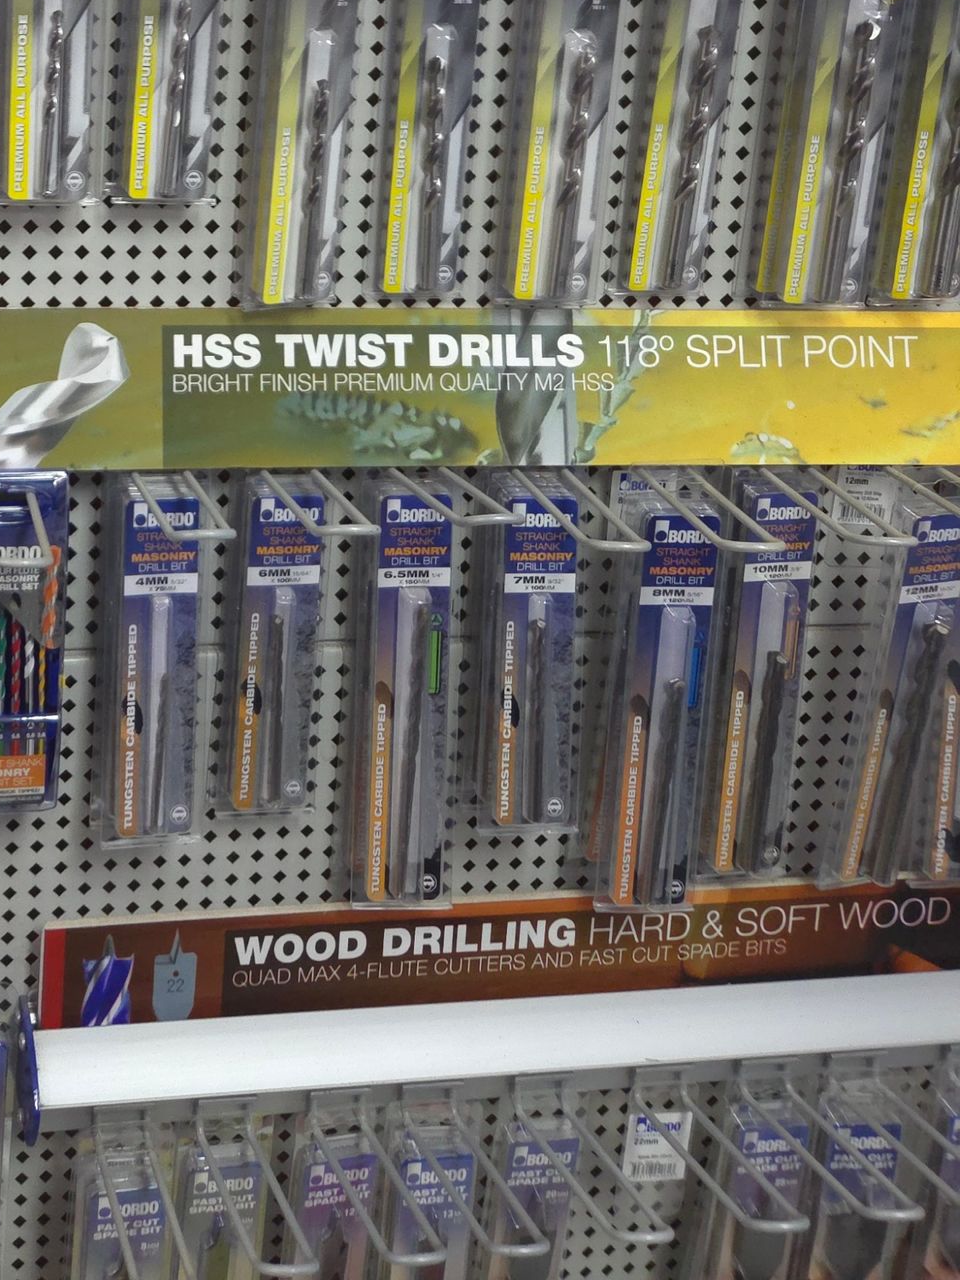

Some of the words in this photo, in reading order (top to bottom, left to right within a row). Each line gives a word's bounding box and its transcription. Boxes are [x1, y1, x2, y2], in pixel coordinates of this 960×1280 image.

[173, 333, 261, 368] HSS
[275, 333, 414, 368] TWIST
[428, 333, 585, 368] DRILLS
[687, 335, 790, 368] SPLIT
[804, 335, 918, 368] POINT
[172, 373, 253, 393] BRIGHT
[260, 373, 327, 392] FINISH
[334, 373, 433, 392] PREMIUM
[440, 373, 527, 392] QUALITY
[535, 373, 564, 391] M2
[572, 373, 614, 391] HSS
[256, 545, 320, 555] MASONRY
[131, 552, 197, 562] MASONRY
[138, 563, 168, 572] DRILL
[171, 561, 188, 571] BIT
[752, 564, 789, 574] 10MM
[258, 569, 290, 577] 6MM
[383, 570, 430, 579] 6.5MM
[135, 577, 169, 586] 4MM
[513, 576, 545, 584] 7MM
[22, 582, 39, 591] SET
[652, 588, 685, 598] 8MM
[127, 624, 137, 680] TIPPED
[125, 685, 136, 746] CARBIDE
[123, 751, 134, 829] TUNGSTEN
[234, 930, 367, 965] WOOD
[382, 917, 576, 958] DRILLING
[589, 912, 691, 945] HARD
[702, 910, 724, 939] &
[736, 903, 830, 938] SOFT
[839, 897, 951, 930] WOOD
[232, 967, 291, 988] QUAD
[297, 964, 341, 983] MAX
[347, 960, 428, 980] 4-FLUTE
[434, 951, 526, 975] CUTTERS
[531, 950, 574, 970] AND
[579, 947, 625, 966] FAST
[632, 944, 671, 963] CUT
[677, 941, 739, 960] SPADE
[745, 938, 787, 956] BITS
[166, 979, 185, 993] 22
